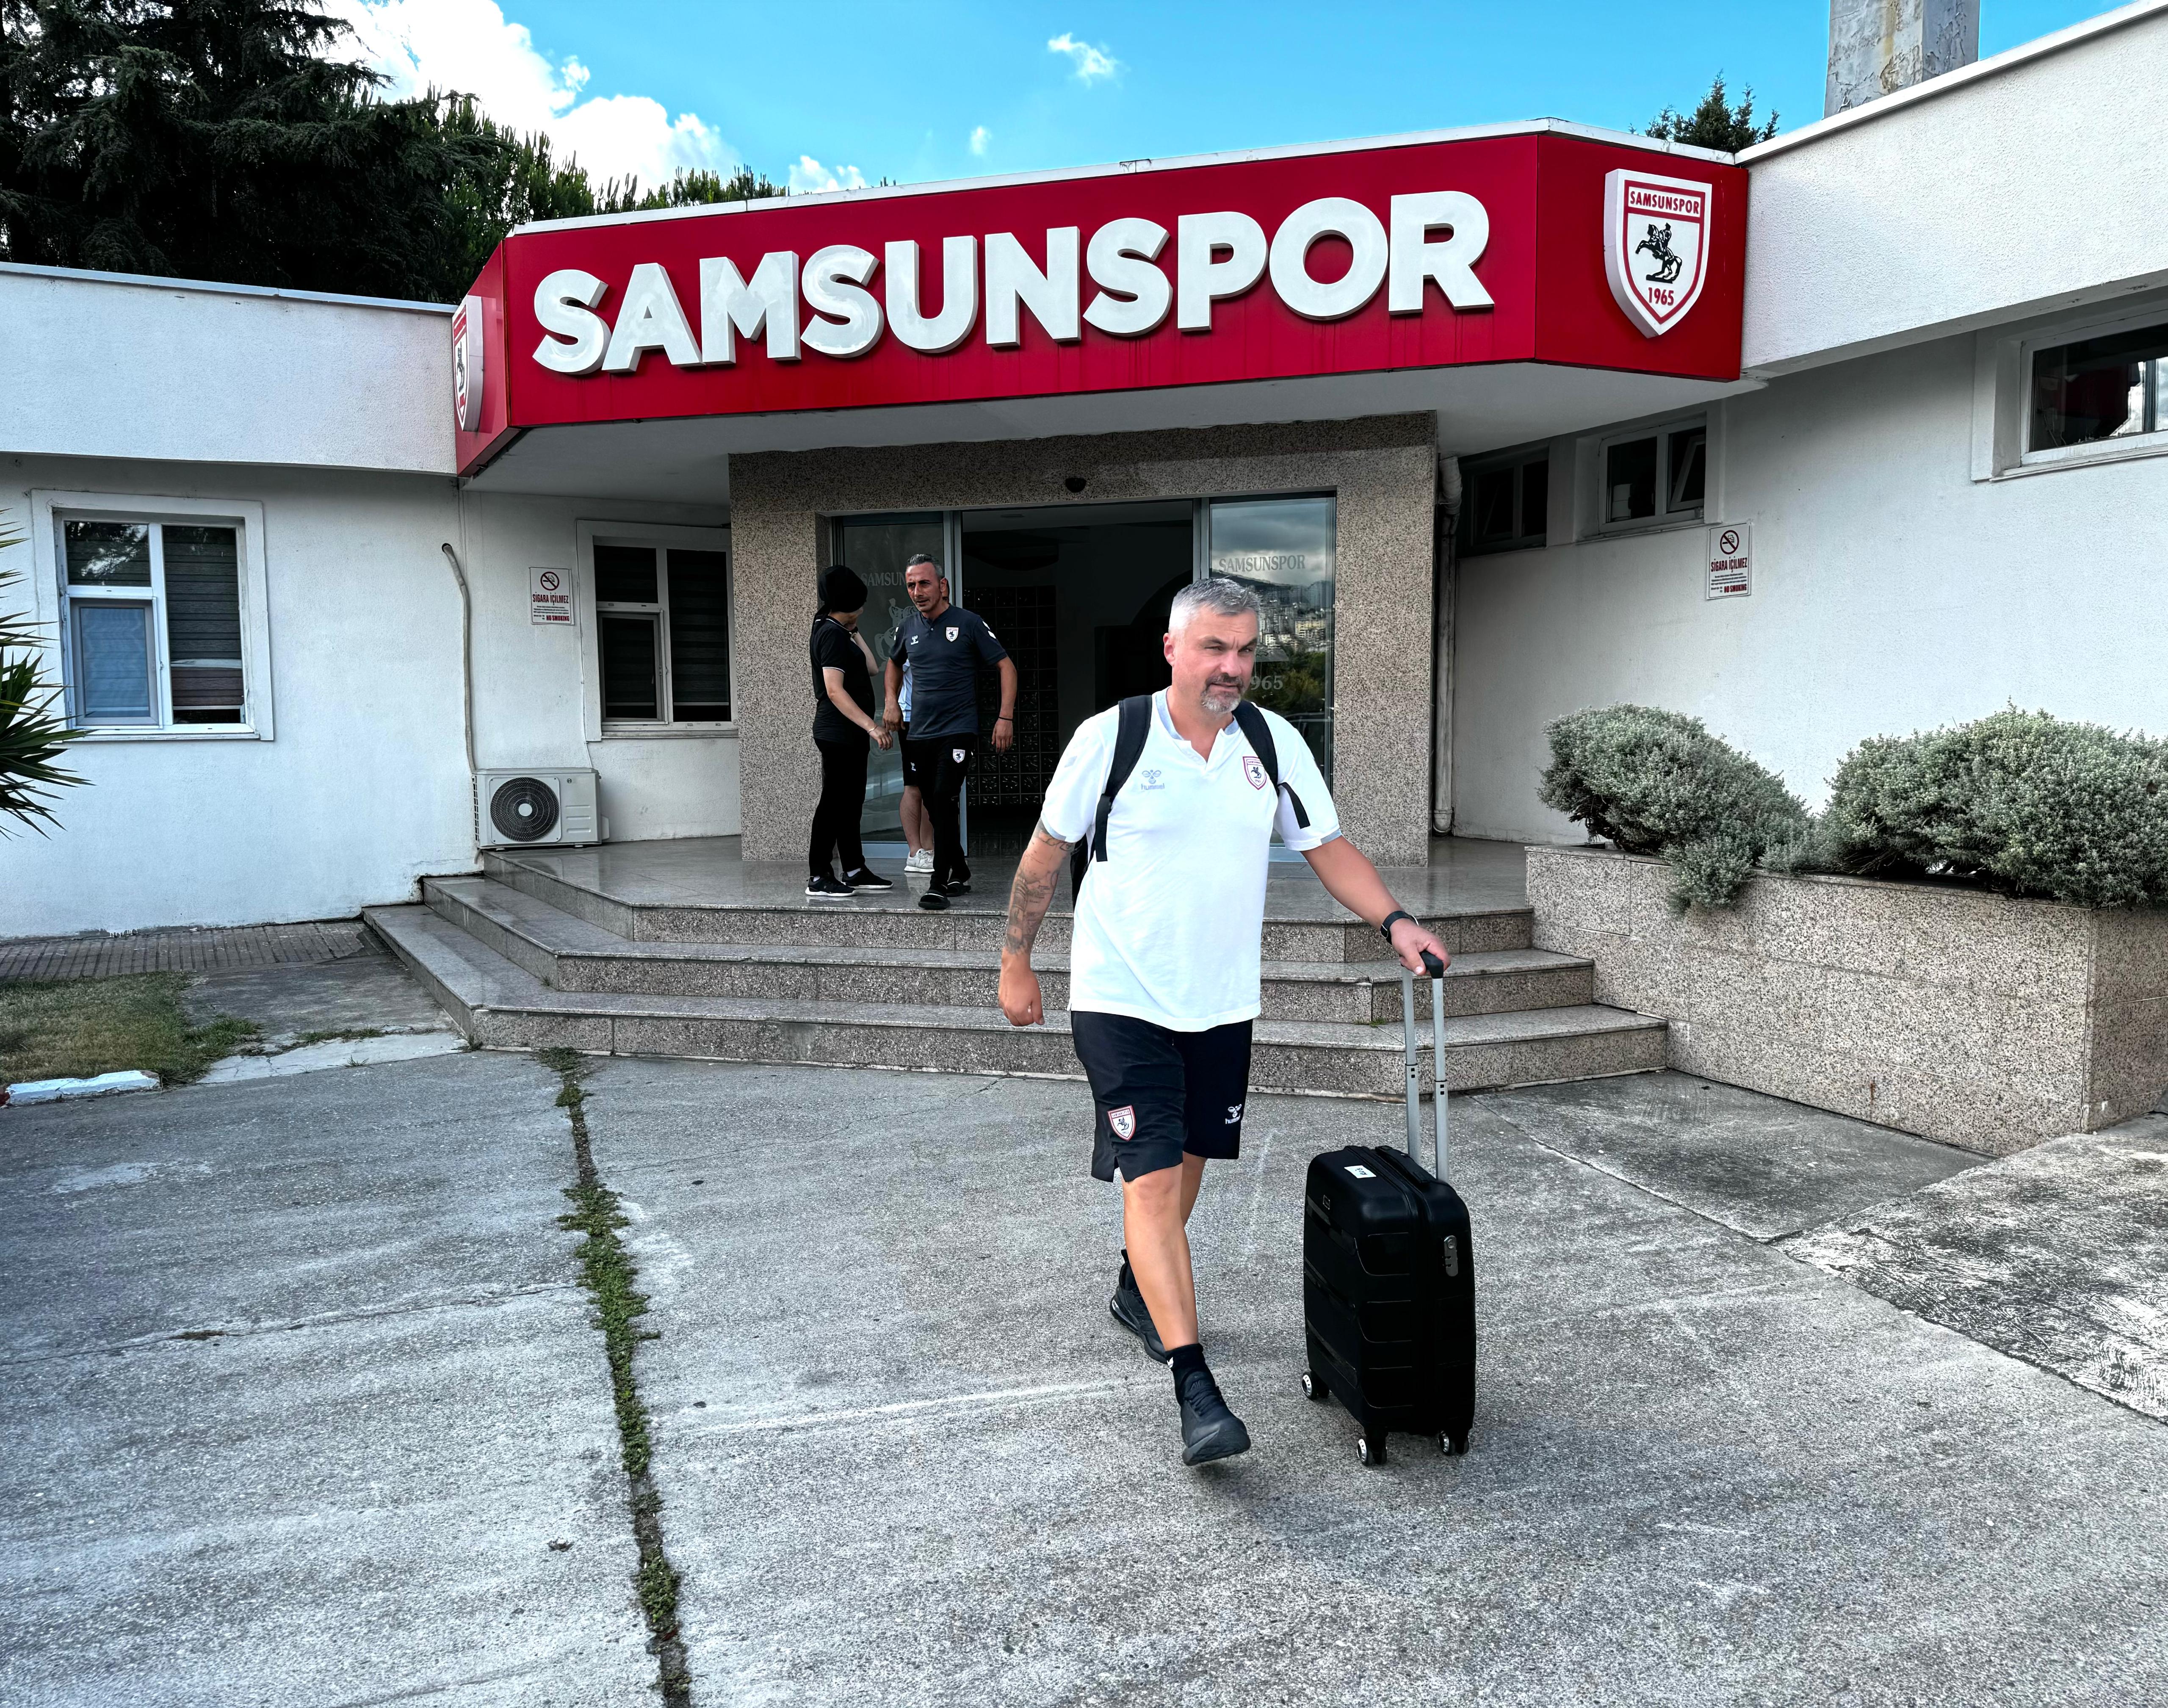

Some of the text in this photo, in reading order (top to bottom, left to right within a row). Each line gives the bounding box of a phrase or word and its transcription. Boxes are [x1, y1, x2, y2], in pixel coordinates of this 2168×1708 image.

[1630, 191, 1699, 214] SAMSUNSPOR
[532, 191, 1495, 375] SAMSUNSPOR
[1648, 287, 1674, 306] 1965
[1219, 555, 1305, 572] SAMSUNSPOR
[1711, 556, 1748, 573] SİGARA İÇİLMEZ
[532, 592, 569, 606] SİGARA İÇİLMEZ
[1250, 675, 1283, 690] 965
